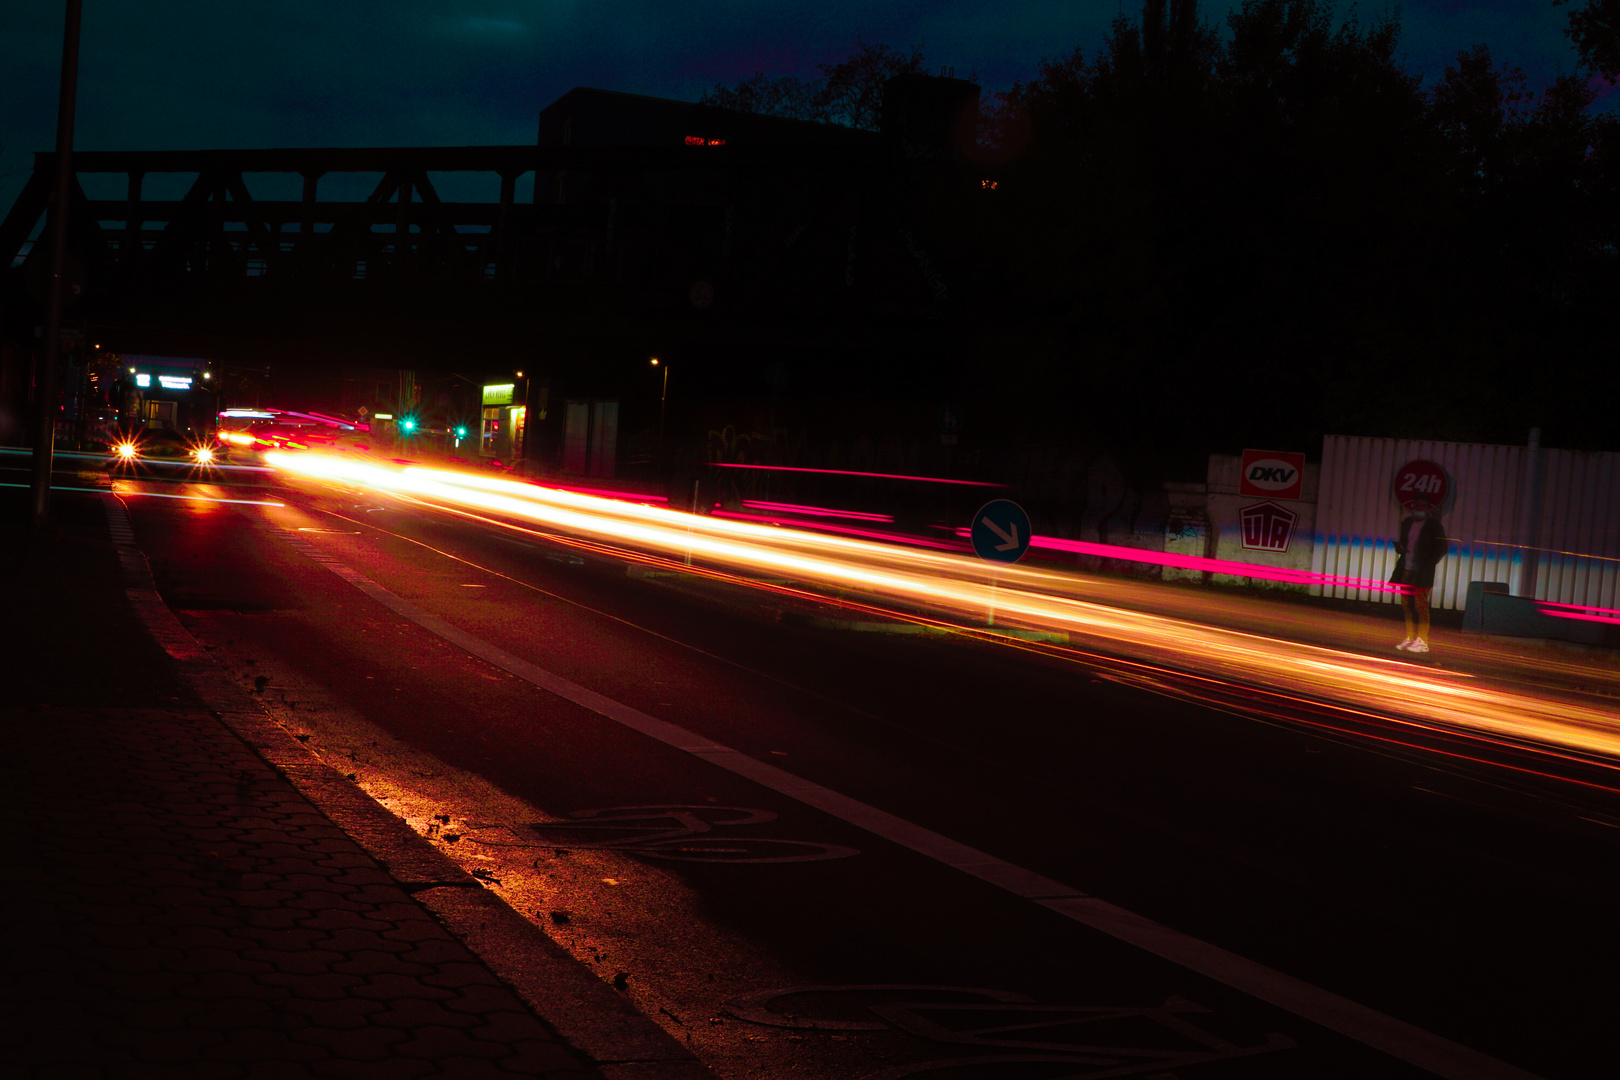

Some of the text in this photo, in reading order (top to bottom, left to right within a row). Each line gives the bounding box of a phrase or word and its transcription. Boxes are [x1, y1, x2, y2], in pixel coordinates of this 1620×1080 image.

[1249, 466, 1296, 483] DKV
[1399, 472, 1442, 494] 24h
[1243, 504, 1293, 548] UTA
